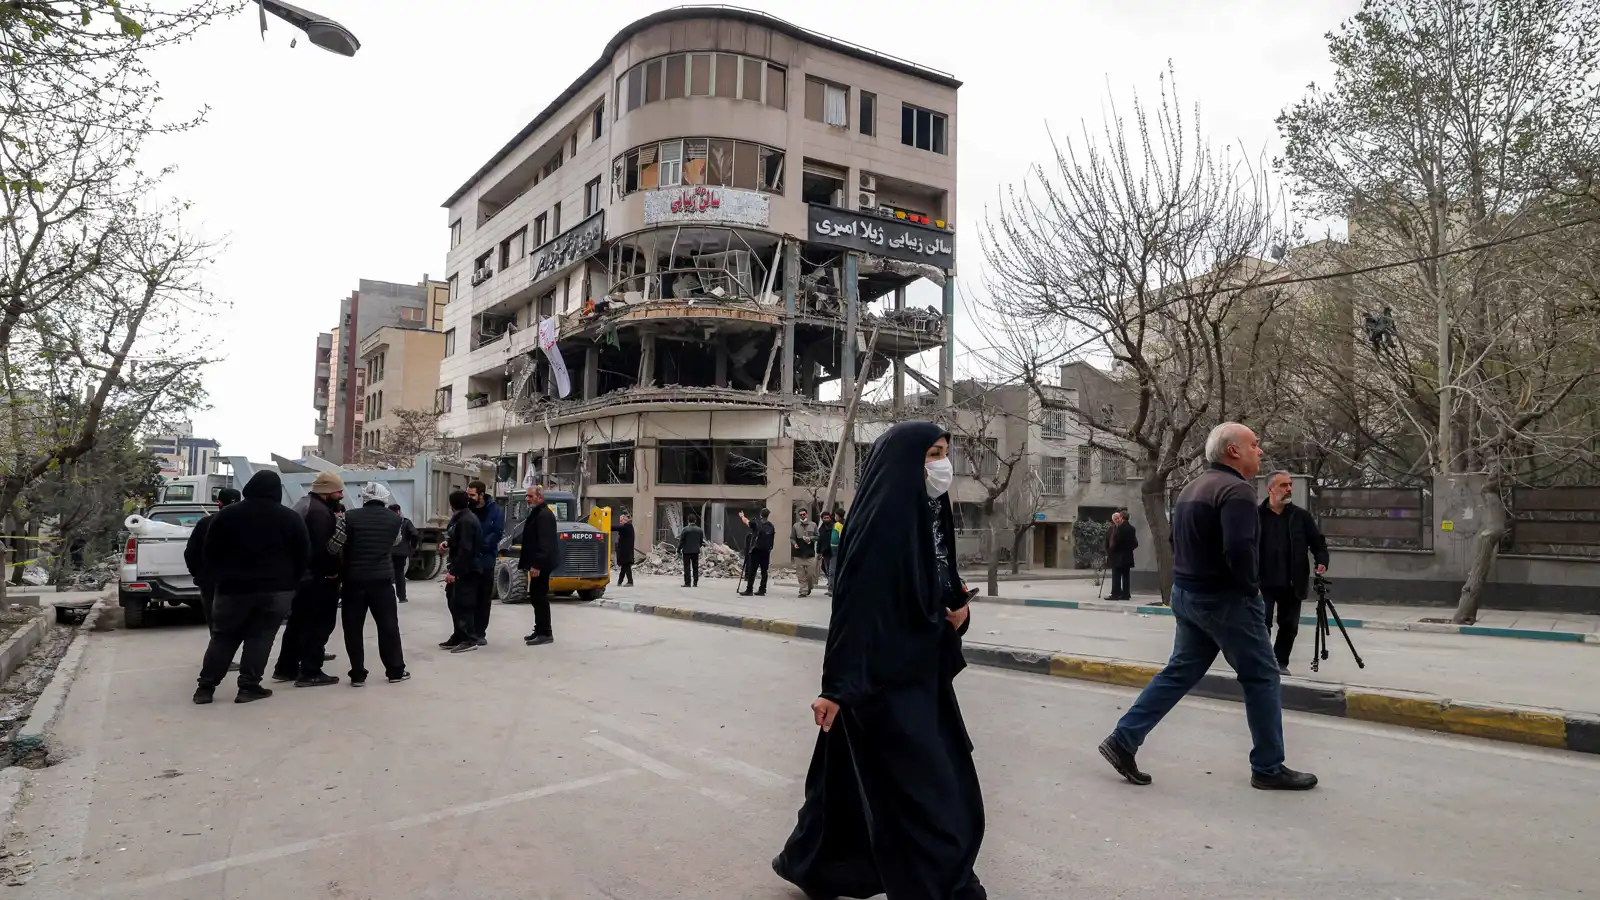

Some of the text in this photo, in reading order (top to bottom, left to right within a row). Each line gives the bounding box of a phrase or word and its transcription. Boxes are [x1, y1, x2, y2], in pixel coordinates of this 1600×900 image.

[815, 219, 952, 255] سالن زیبایی ژیلا امیری
